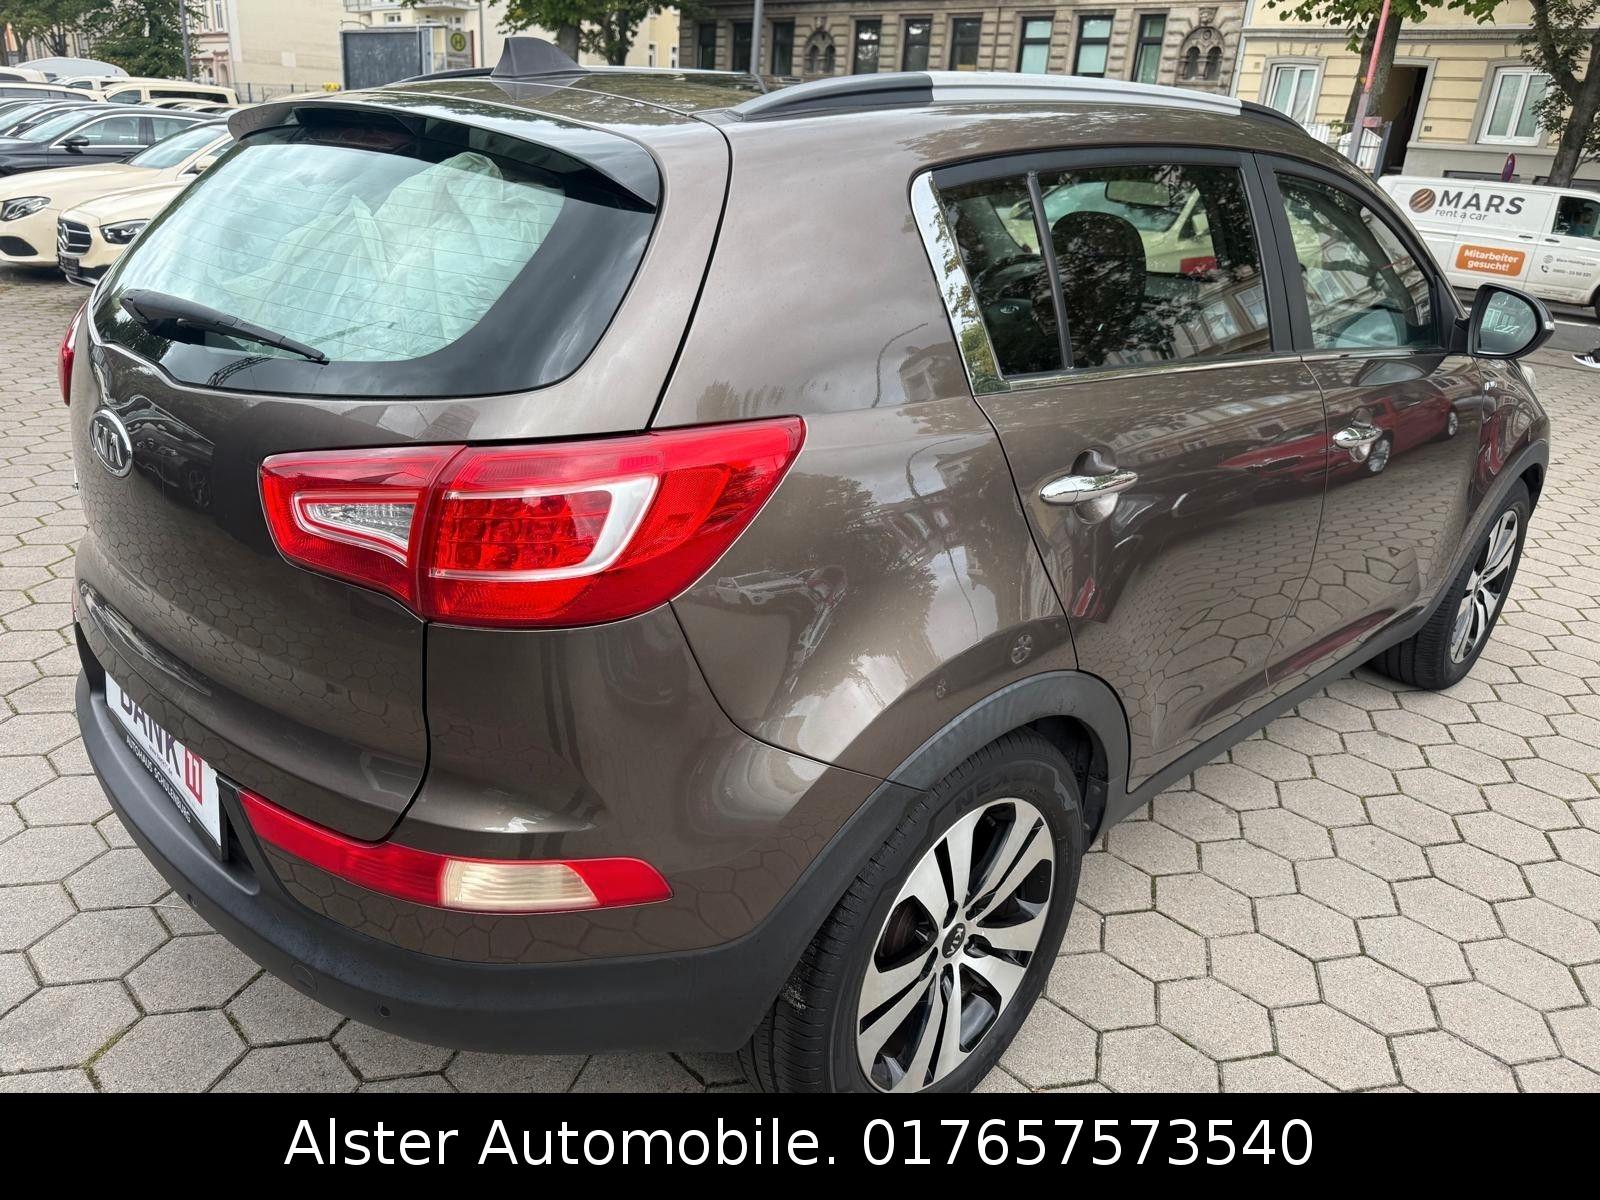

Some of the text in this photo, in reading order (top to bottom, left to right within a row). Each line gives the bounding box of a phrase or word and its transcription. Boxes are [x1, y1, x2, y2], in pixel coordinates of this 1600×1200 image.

[1438, 190, 1526, 215] MARS
[1435, 208, 1488, 221] rent a car
[1463, 248, 1519, 263] Mitarbeiter
[1467, 259, 1510, 272] gesucht!
